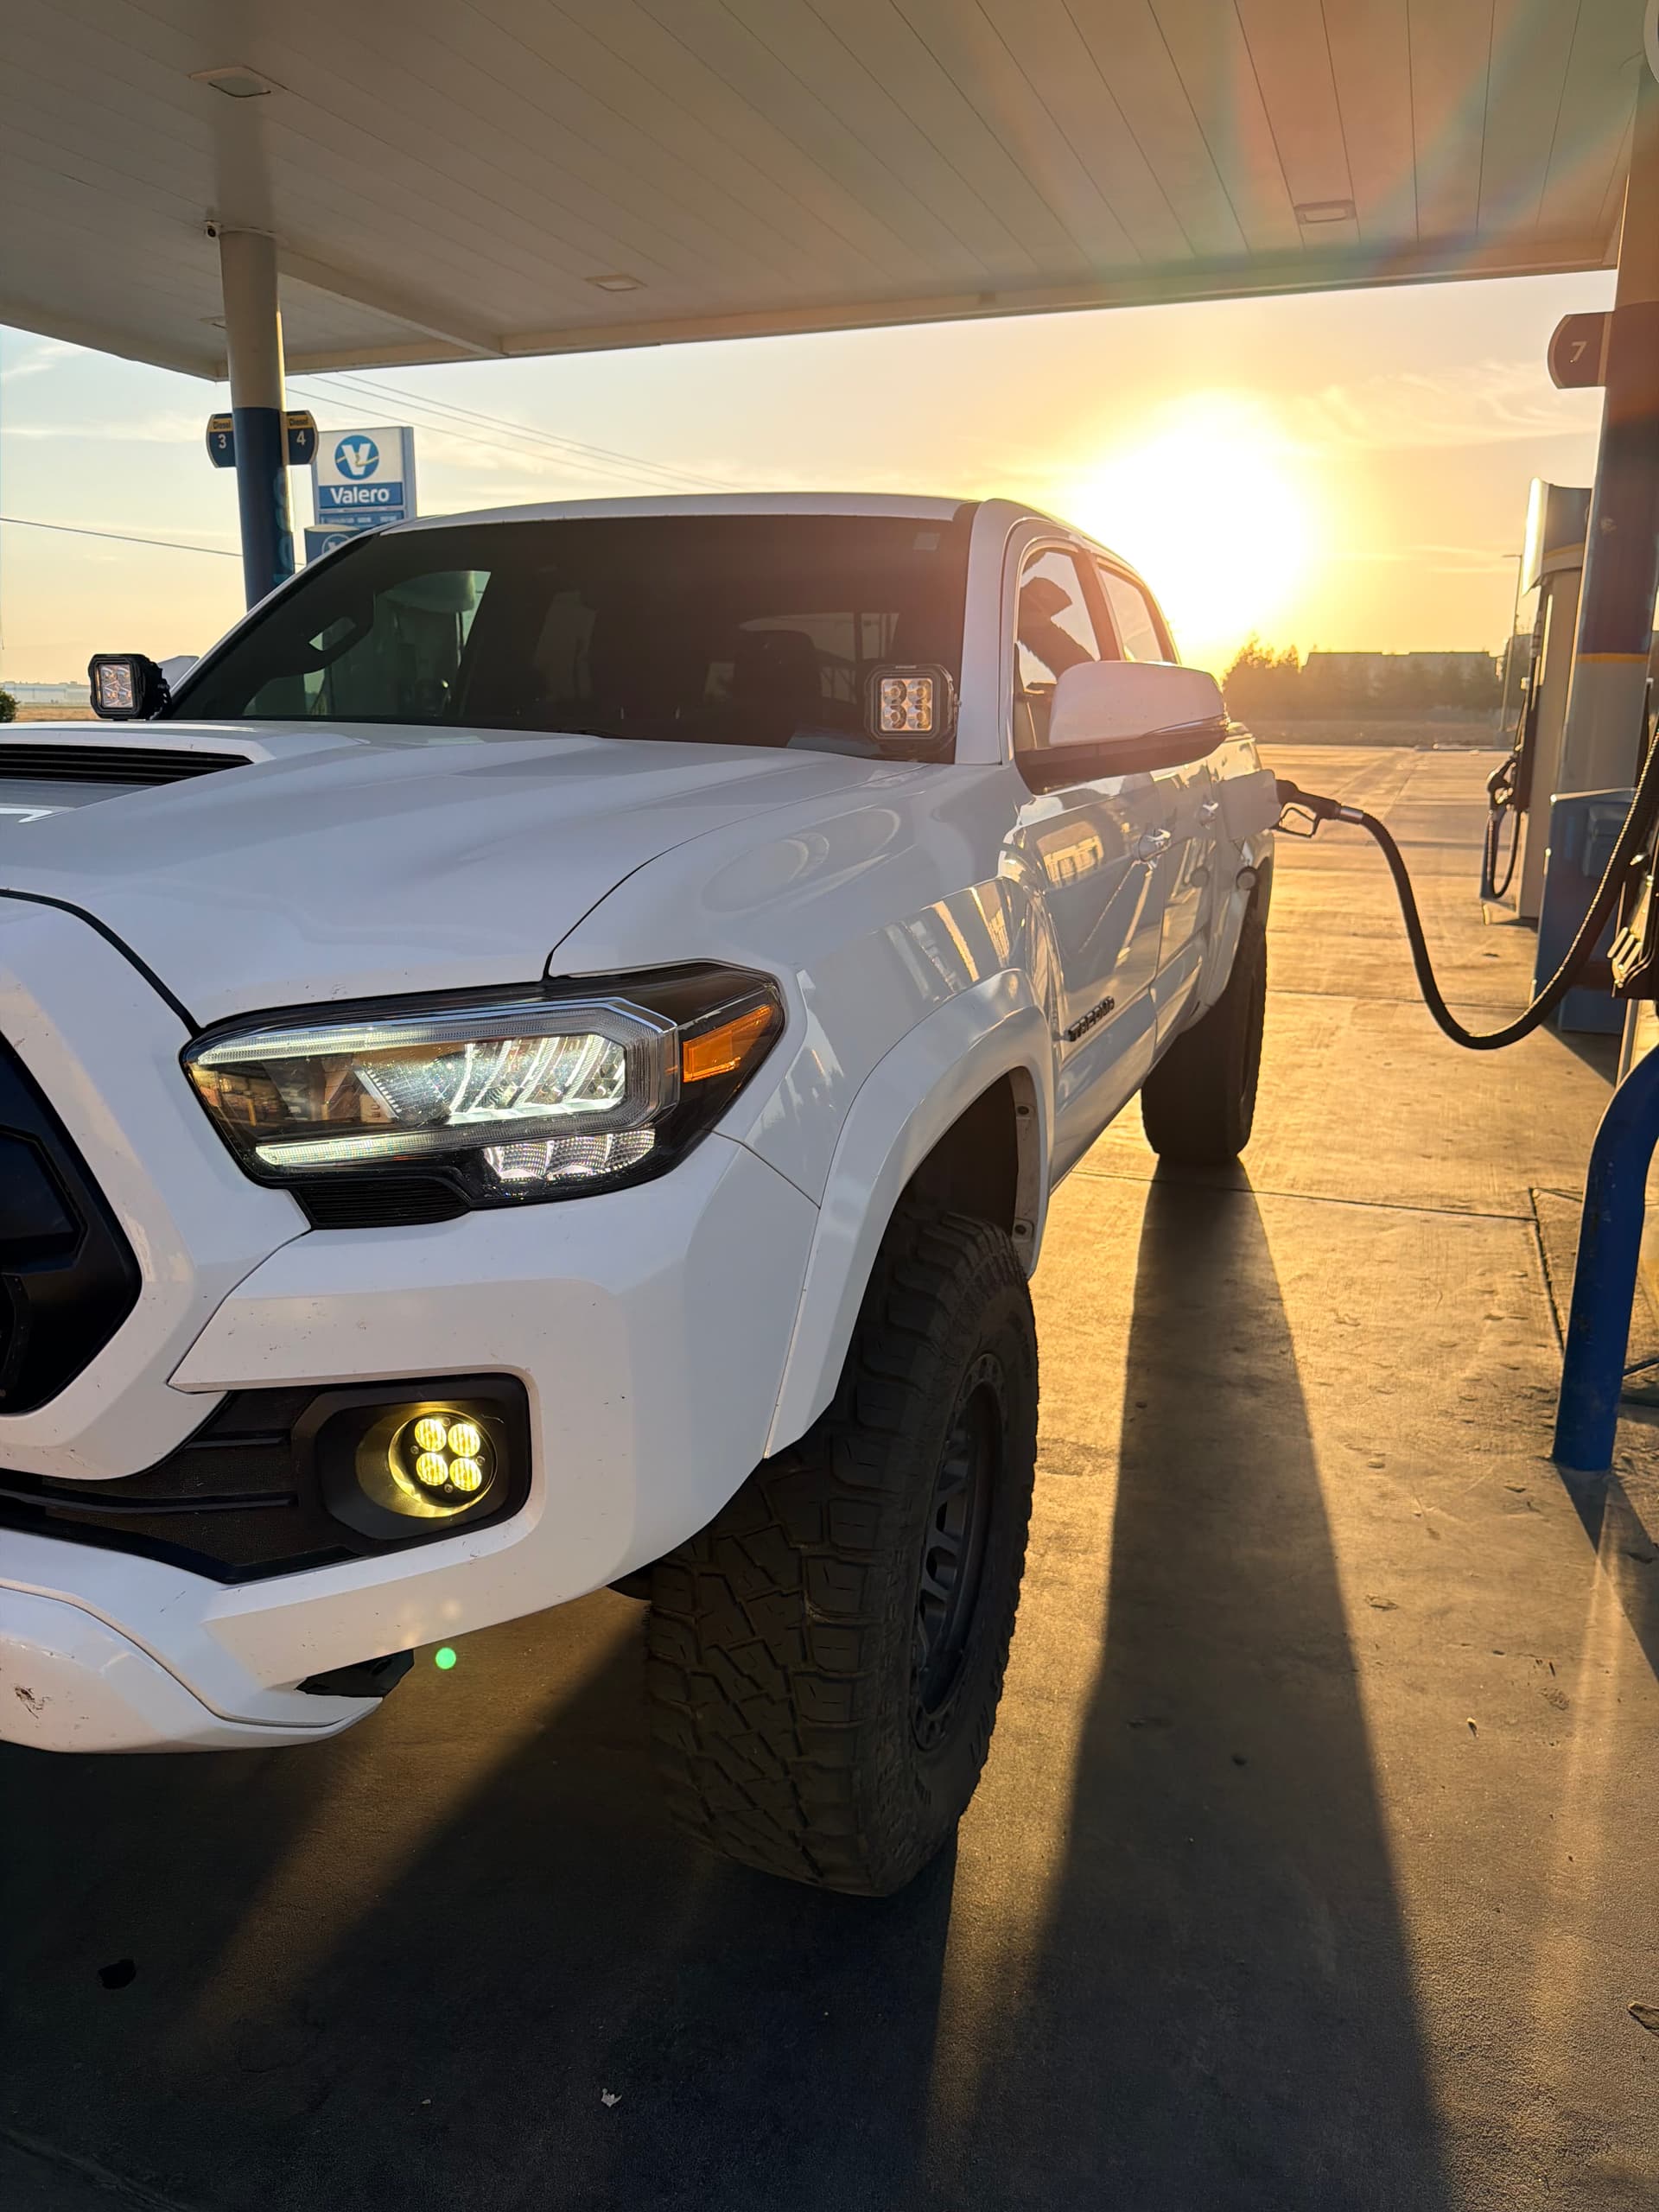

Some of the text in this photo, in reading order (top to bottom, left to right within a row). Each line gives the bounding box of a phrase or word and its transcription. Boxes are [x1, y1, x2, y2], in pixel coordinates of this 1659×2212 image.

[1569, 340, 1587, 363] 7
[218, 434, 226, 448] 3
[296, 430, 306, 445] 4
[330, 486, 390, 504] Valero
